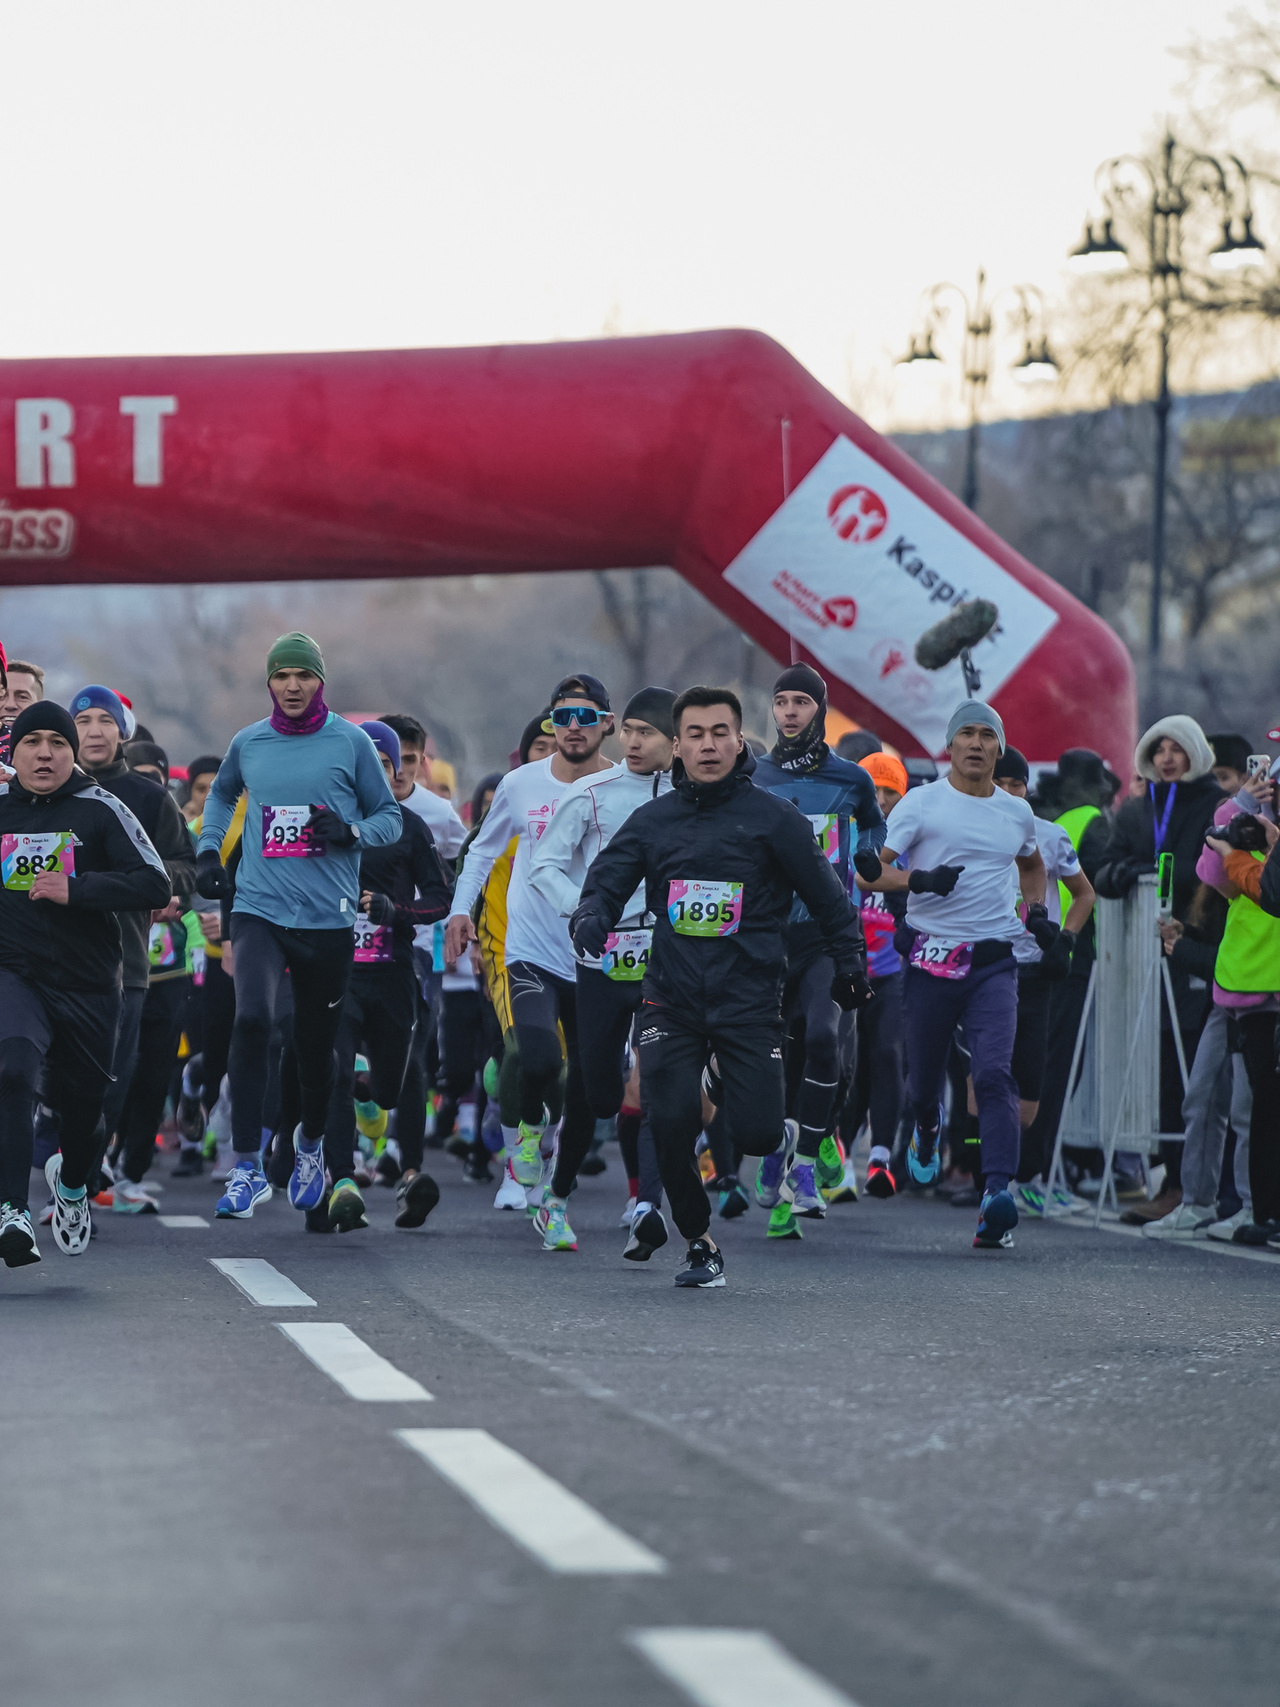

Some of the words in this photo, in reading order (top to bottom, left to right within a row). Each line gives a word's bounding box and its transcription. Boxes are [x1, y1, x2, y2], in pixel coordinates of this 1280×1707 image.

[272, 825, 313, 844] 935
[16, 854, 60, 876] 882
[676, 901, 735, 923] 1895
[609, 949, 649, 968] 164
